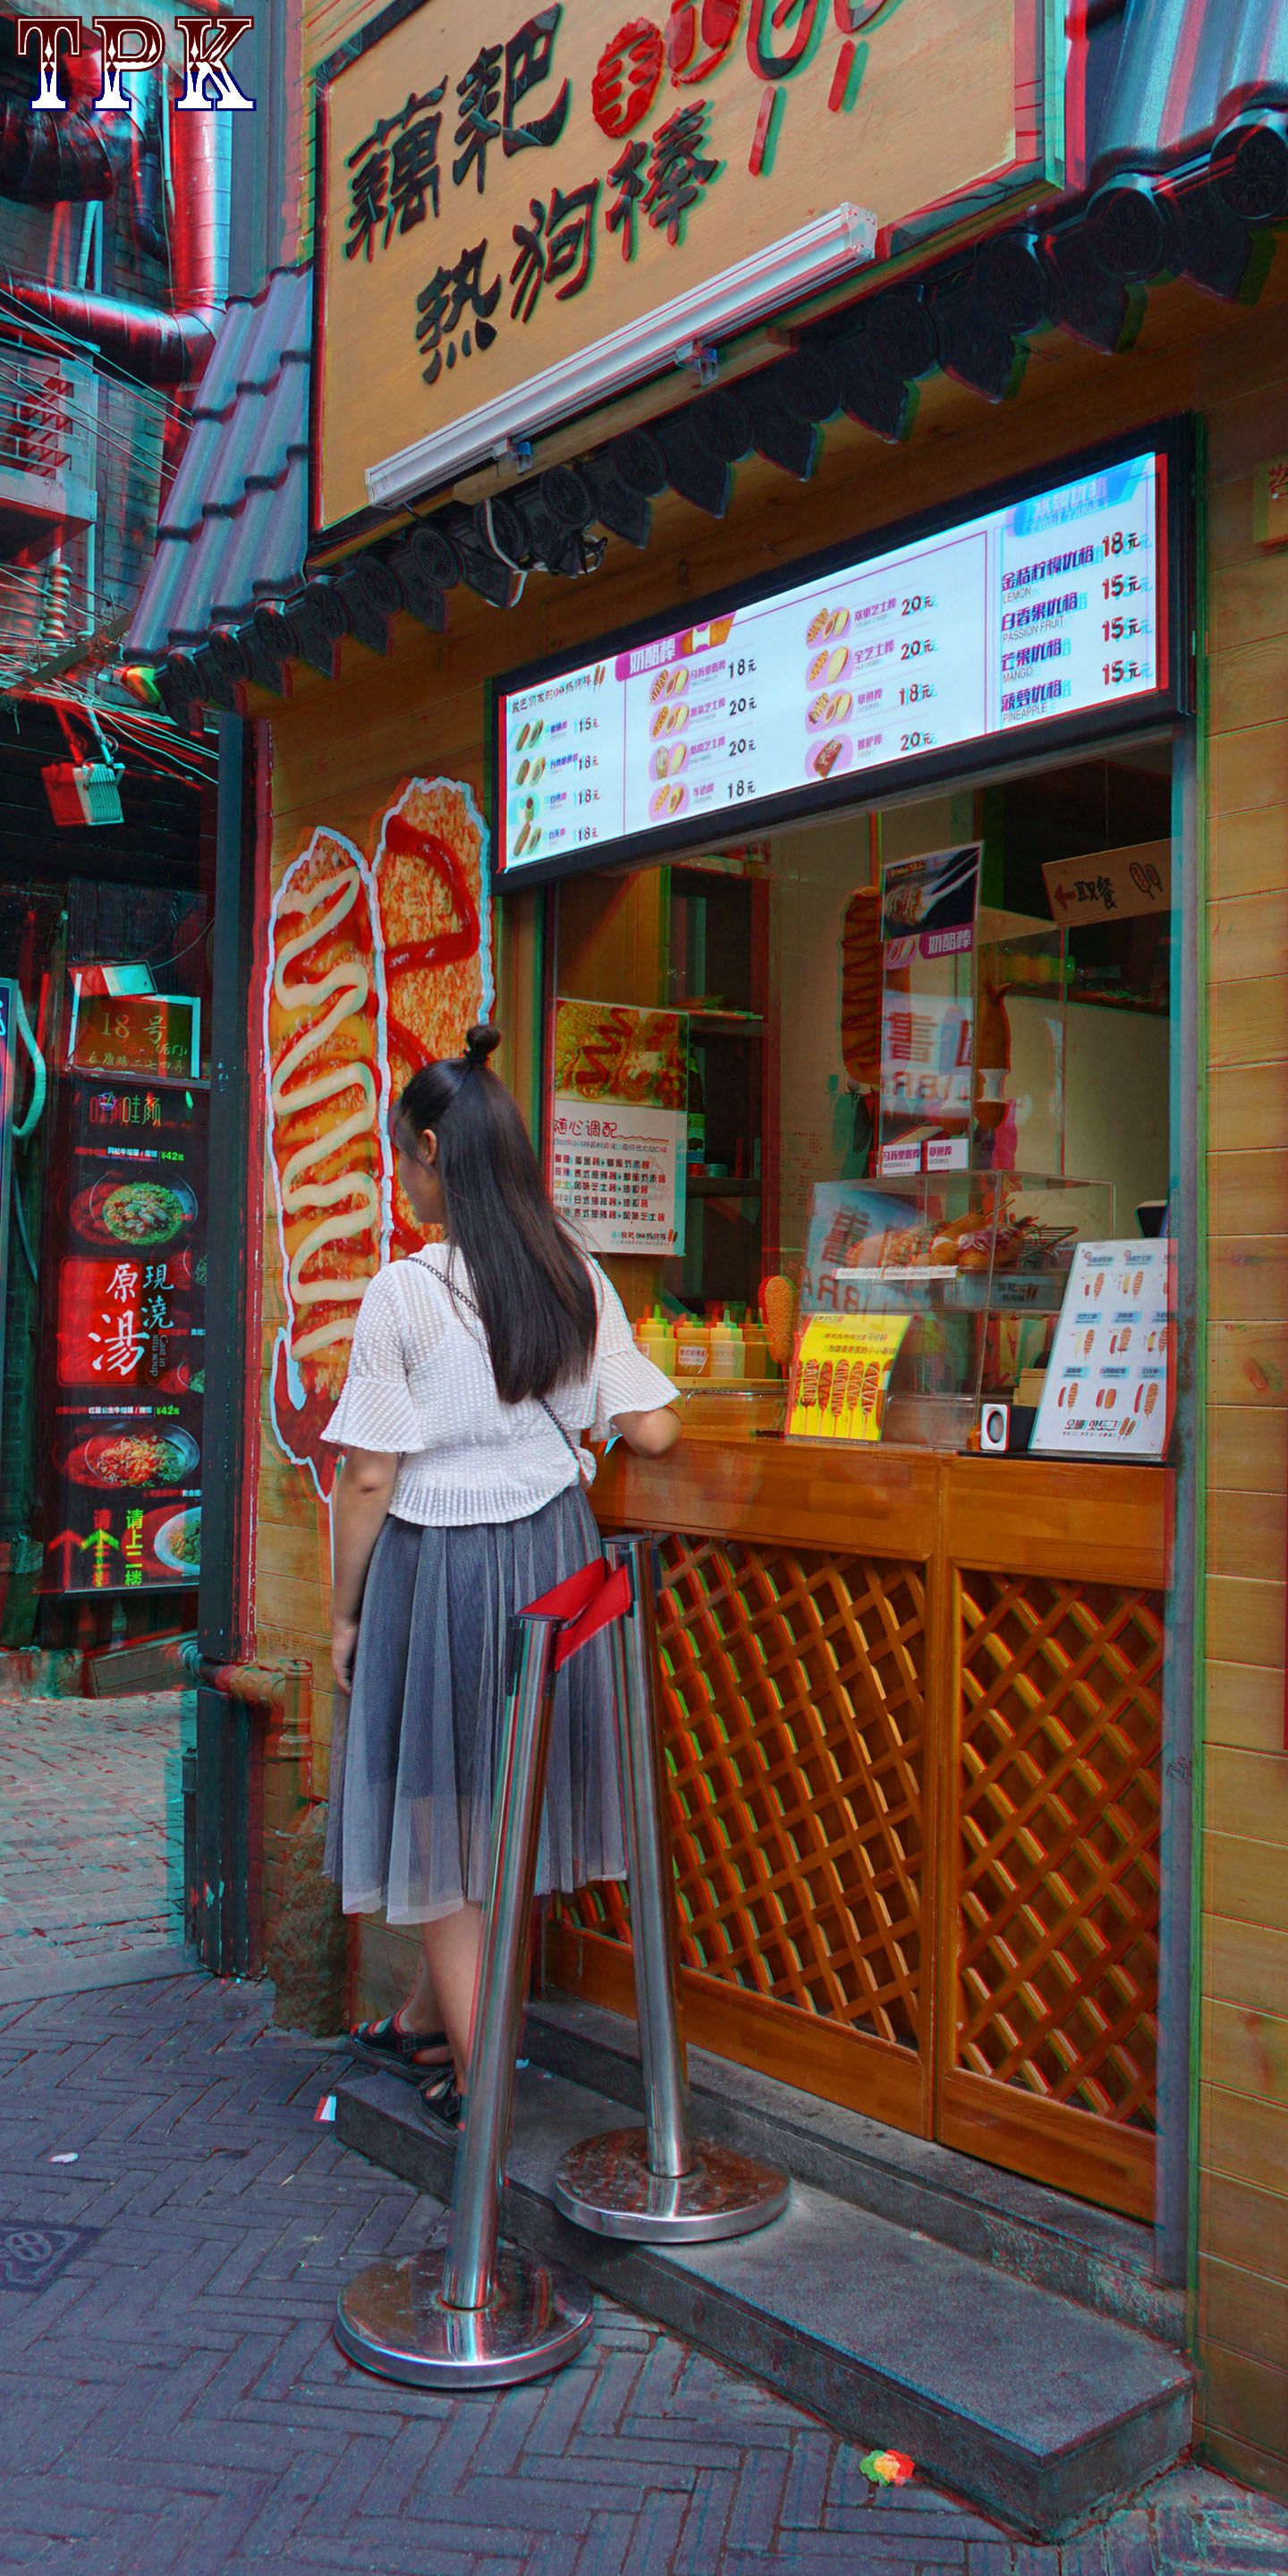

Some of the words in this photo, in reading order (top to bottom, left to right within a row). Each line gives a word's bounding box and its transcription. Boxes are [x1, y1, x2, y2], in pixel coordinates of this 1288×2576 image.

[415, 98, 721, 386] 热狗棒
[1003, 588, 1031, 605] LEMON
[1003, 624, 1038, 642] PASSION
[1040, 615, 1064, 631] FRUIT
[1003, 666, 1033, 683] MANGO
[1003, 703, 1047, 724] PINEAPPLE
[1073, 875, 1116, 910] 取餐
[928, 929, 972, 955] 奶酪棒
[101, 1013, 131, 1038] 18
[142, 1015, 168, 1045] 号
[149, 1353, 159, 1377] soup
[124, 1508, 145, 1587] 请上二楼
